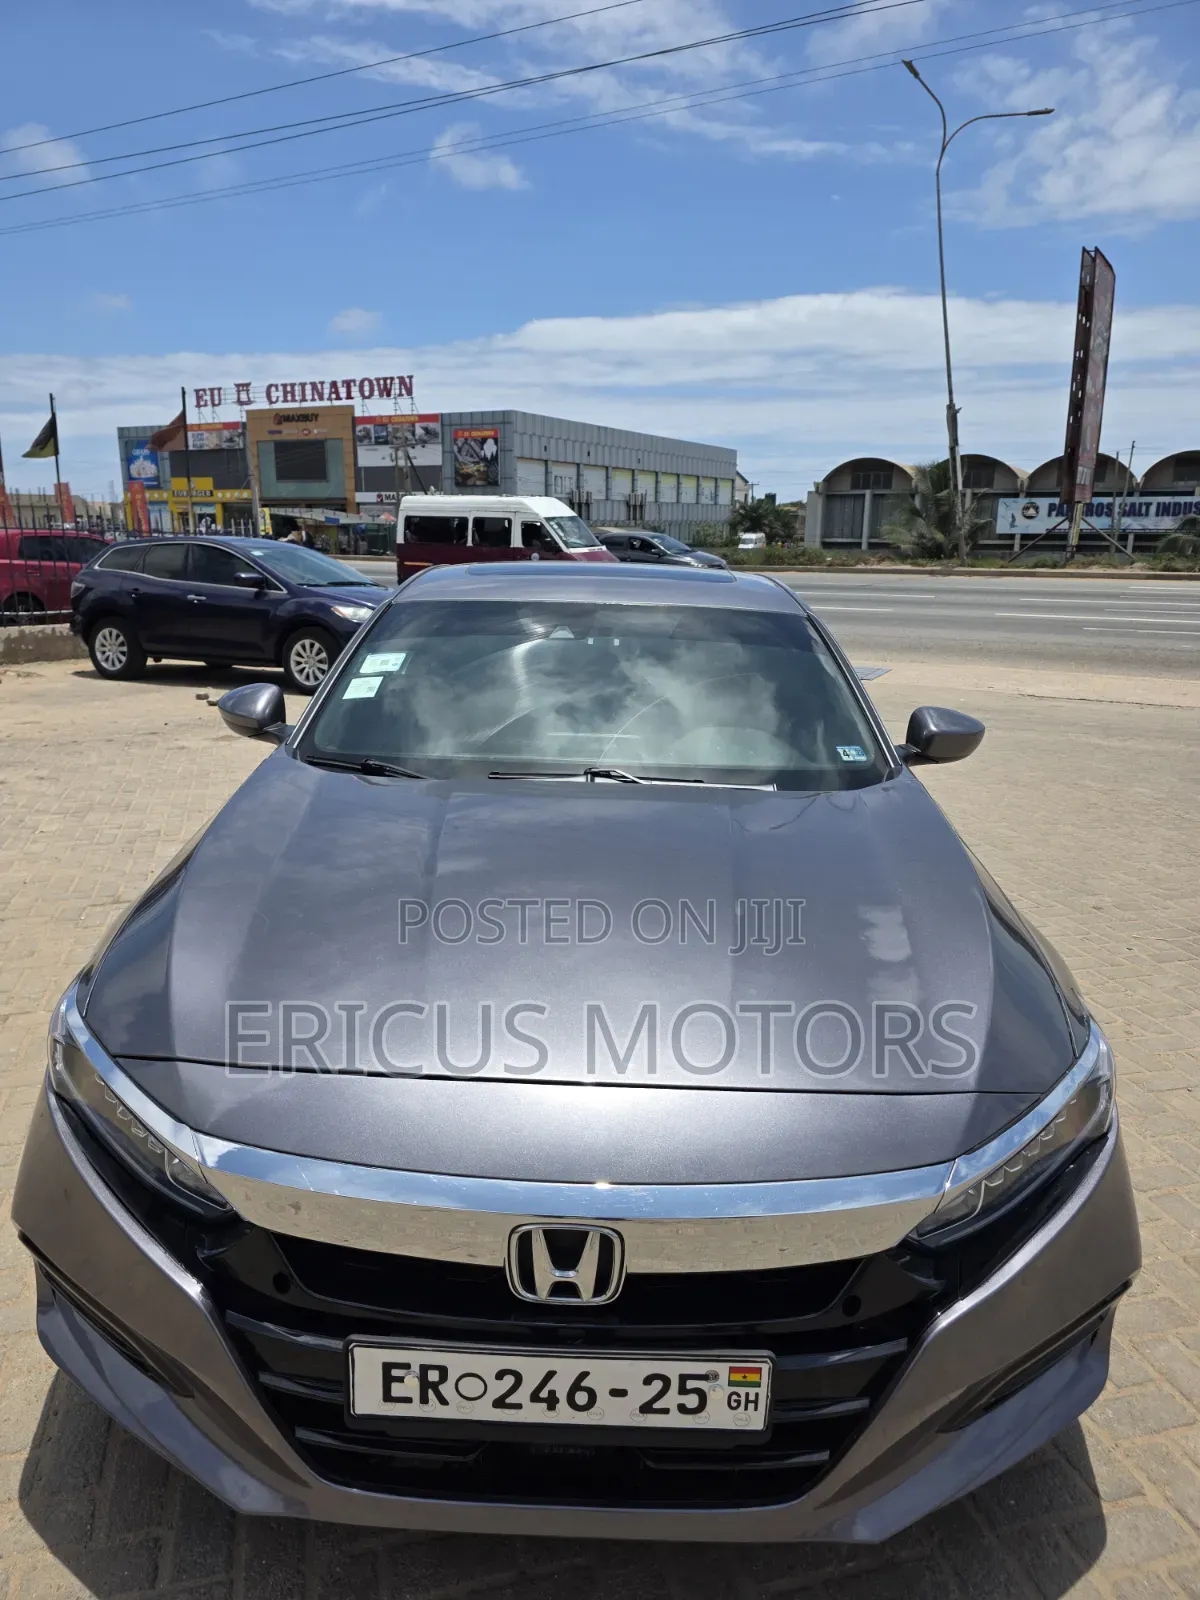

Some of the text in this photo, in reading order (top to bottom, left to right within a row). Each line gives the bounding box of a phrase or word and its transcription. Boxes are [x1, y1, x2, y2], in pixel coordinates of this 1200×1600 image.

[194, 375, 414, 408] EU CHINATOWN
[1047, 502, 1113, 517] PAROS
[1118, 502, 1153, 517] SALT
[727, 1390, 760, 1412] GH
